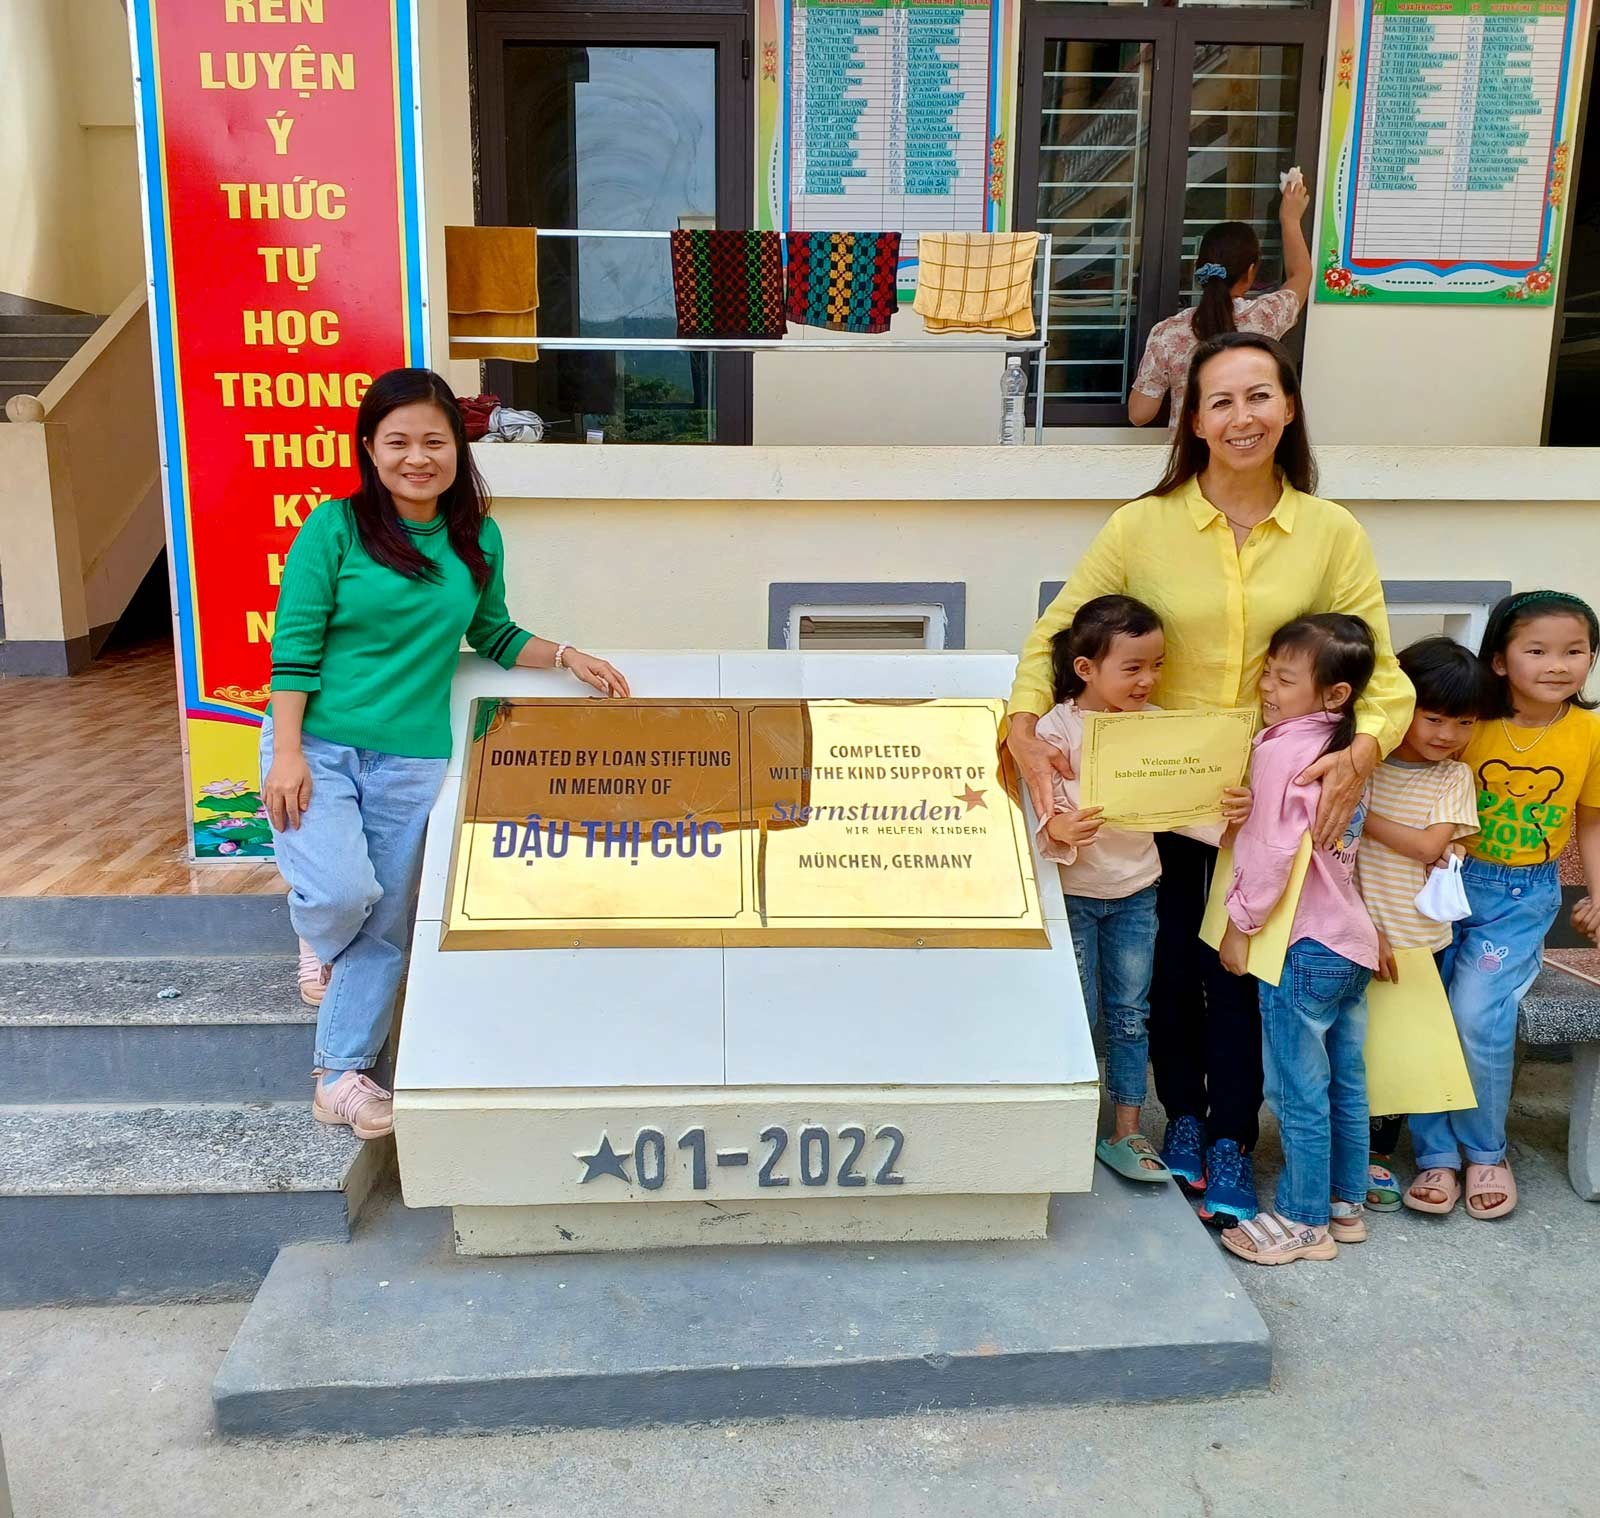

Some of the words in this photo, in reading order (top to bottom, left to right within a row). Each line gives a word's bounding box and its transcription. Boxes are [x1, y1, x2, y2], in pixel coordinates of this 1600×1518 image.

[199, 44, 355, 98] LUYỆN
[265, 110, 295, 155] Ý
[219, 175, 347, 220] THỨC
[257, 243, 322, 291] TỰ
[243, 310, 340, 354] HỌC
[213, 372, 373, 408] TRONG
[244, 425, 352, 468] THỜI
[491, 750, 571, 767] DONATED
[576, 750, 598, 767] BY
[602, 750, 646, 767] LOAN
[650, 750, 731, 767] STIFTUNG
[830, 745, 921, 759] COMPLETED
[1141, 757, 1182, 767] Welcome
[1182, 755, 1201, 765] Mrs
[769, 766, 811, 780] WITH
[814, 766, 843, 780] THE
[848, 766, 886, 780] KIND
[891, 766, 962, 780] SUPPORT
[966, 766, 986, 780] OF
[1114, 769, 1148, 779] Isabelle
[1149, 768, 1178, 778] muller
[1179, 767, 1188, 776] to
[549, 778, 567, 795] IN
[571, 778, 647, 795] MEMORY
[651, 778, 672, 795] OF
[771, 799, 963, 822] Sternstunden
[493, 813, 570, 866] ĐẬU
[581, 820, 641, 866] THỊ
[650, 812, 723, 858] CÚC
[845, 826, 869, 835] WIR
[878, 826, 923, 835] HELFEN
[931, 826, 987, 835] KINDERN
[799, 852, 889, 871] MÜNCHEN,
[891, 853, 973, 869] GERMANY
[1475, 841, 1517, 860] ART
[634, 1124, 905, 1190] 01-2022
